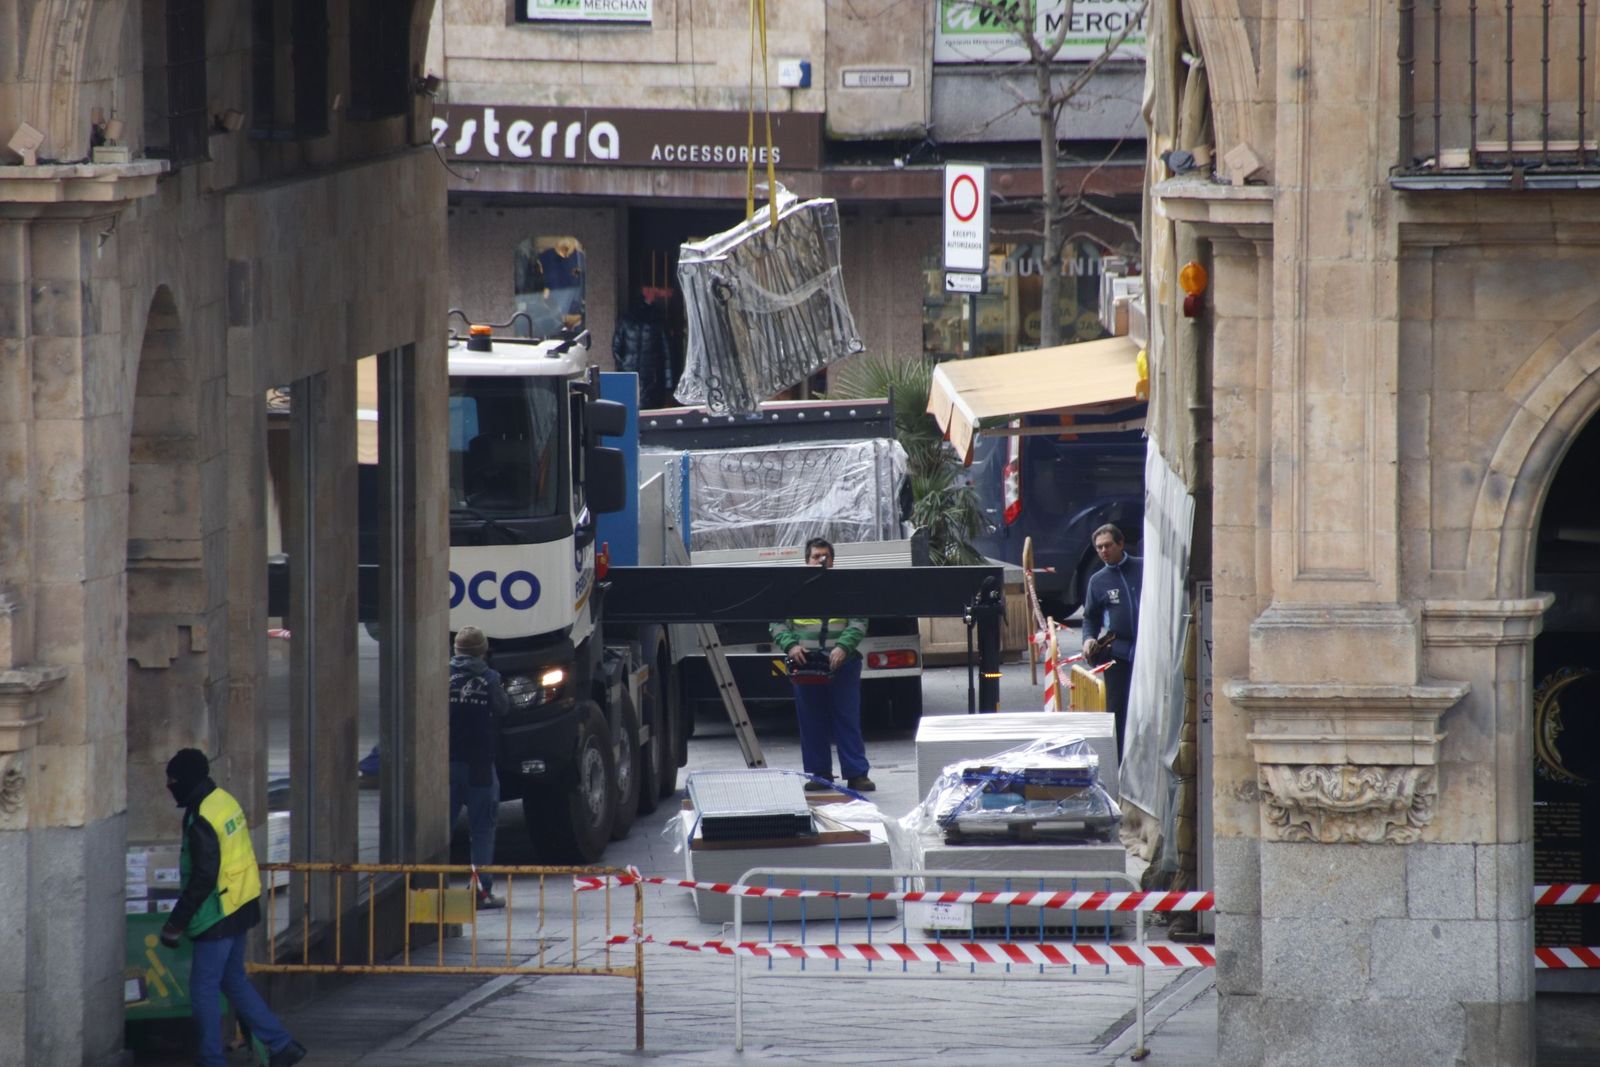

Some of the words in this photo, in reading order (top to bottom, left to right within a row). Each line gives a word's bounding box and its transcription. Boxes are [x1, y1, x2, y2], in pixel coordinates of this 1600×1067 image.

[1045, 12, 1146, 32] MERCH
[651, 144, 781, 164] ACCESSORIES
[952, 230, 977, 239] EXCEPTO
